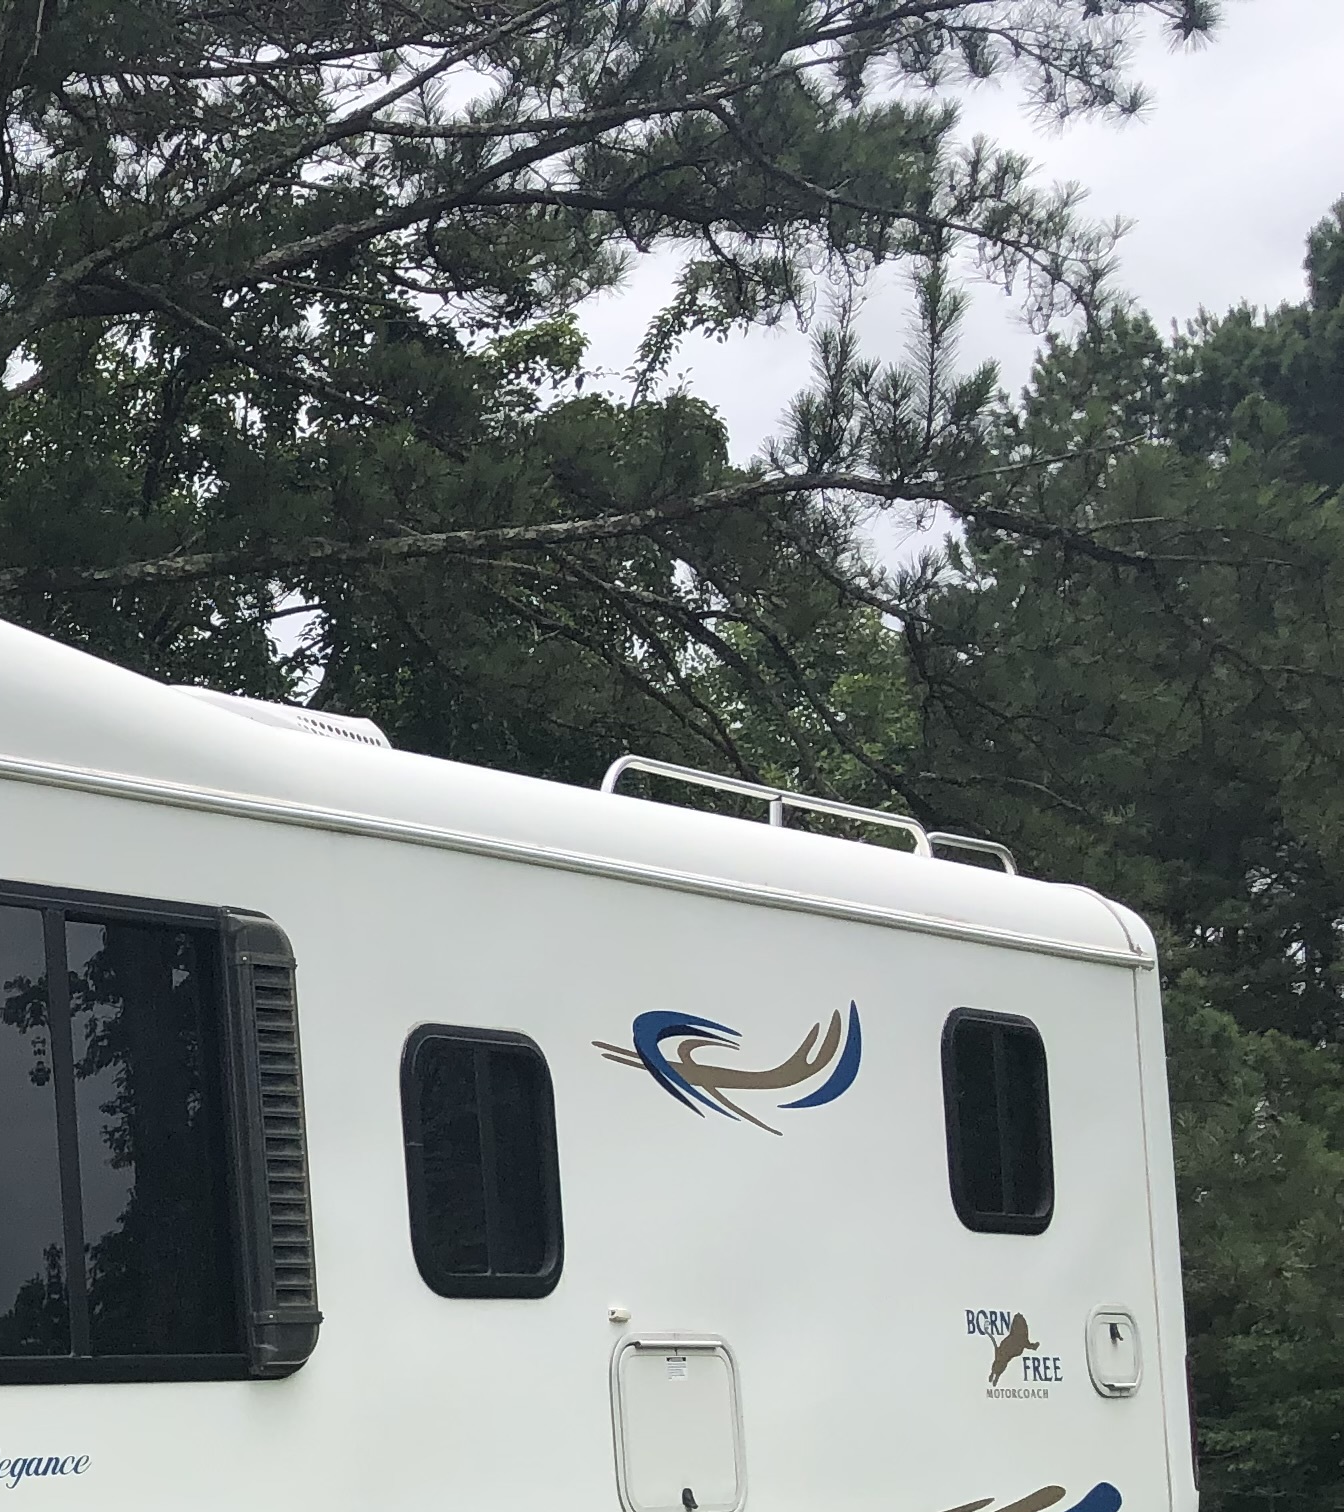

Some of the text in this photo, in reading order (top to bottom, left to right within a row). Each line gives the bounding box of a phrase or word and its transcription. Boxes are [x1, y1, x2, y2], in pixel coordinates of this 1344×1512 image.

[965, 1309, 1011, 1336] BORN
[1022, 1356, 1063, 1382] FREE
[986, 1388, 1049, 1398] MOTORCOACH
